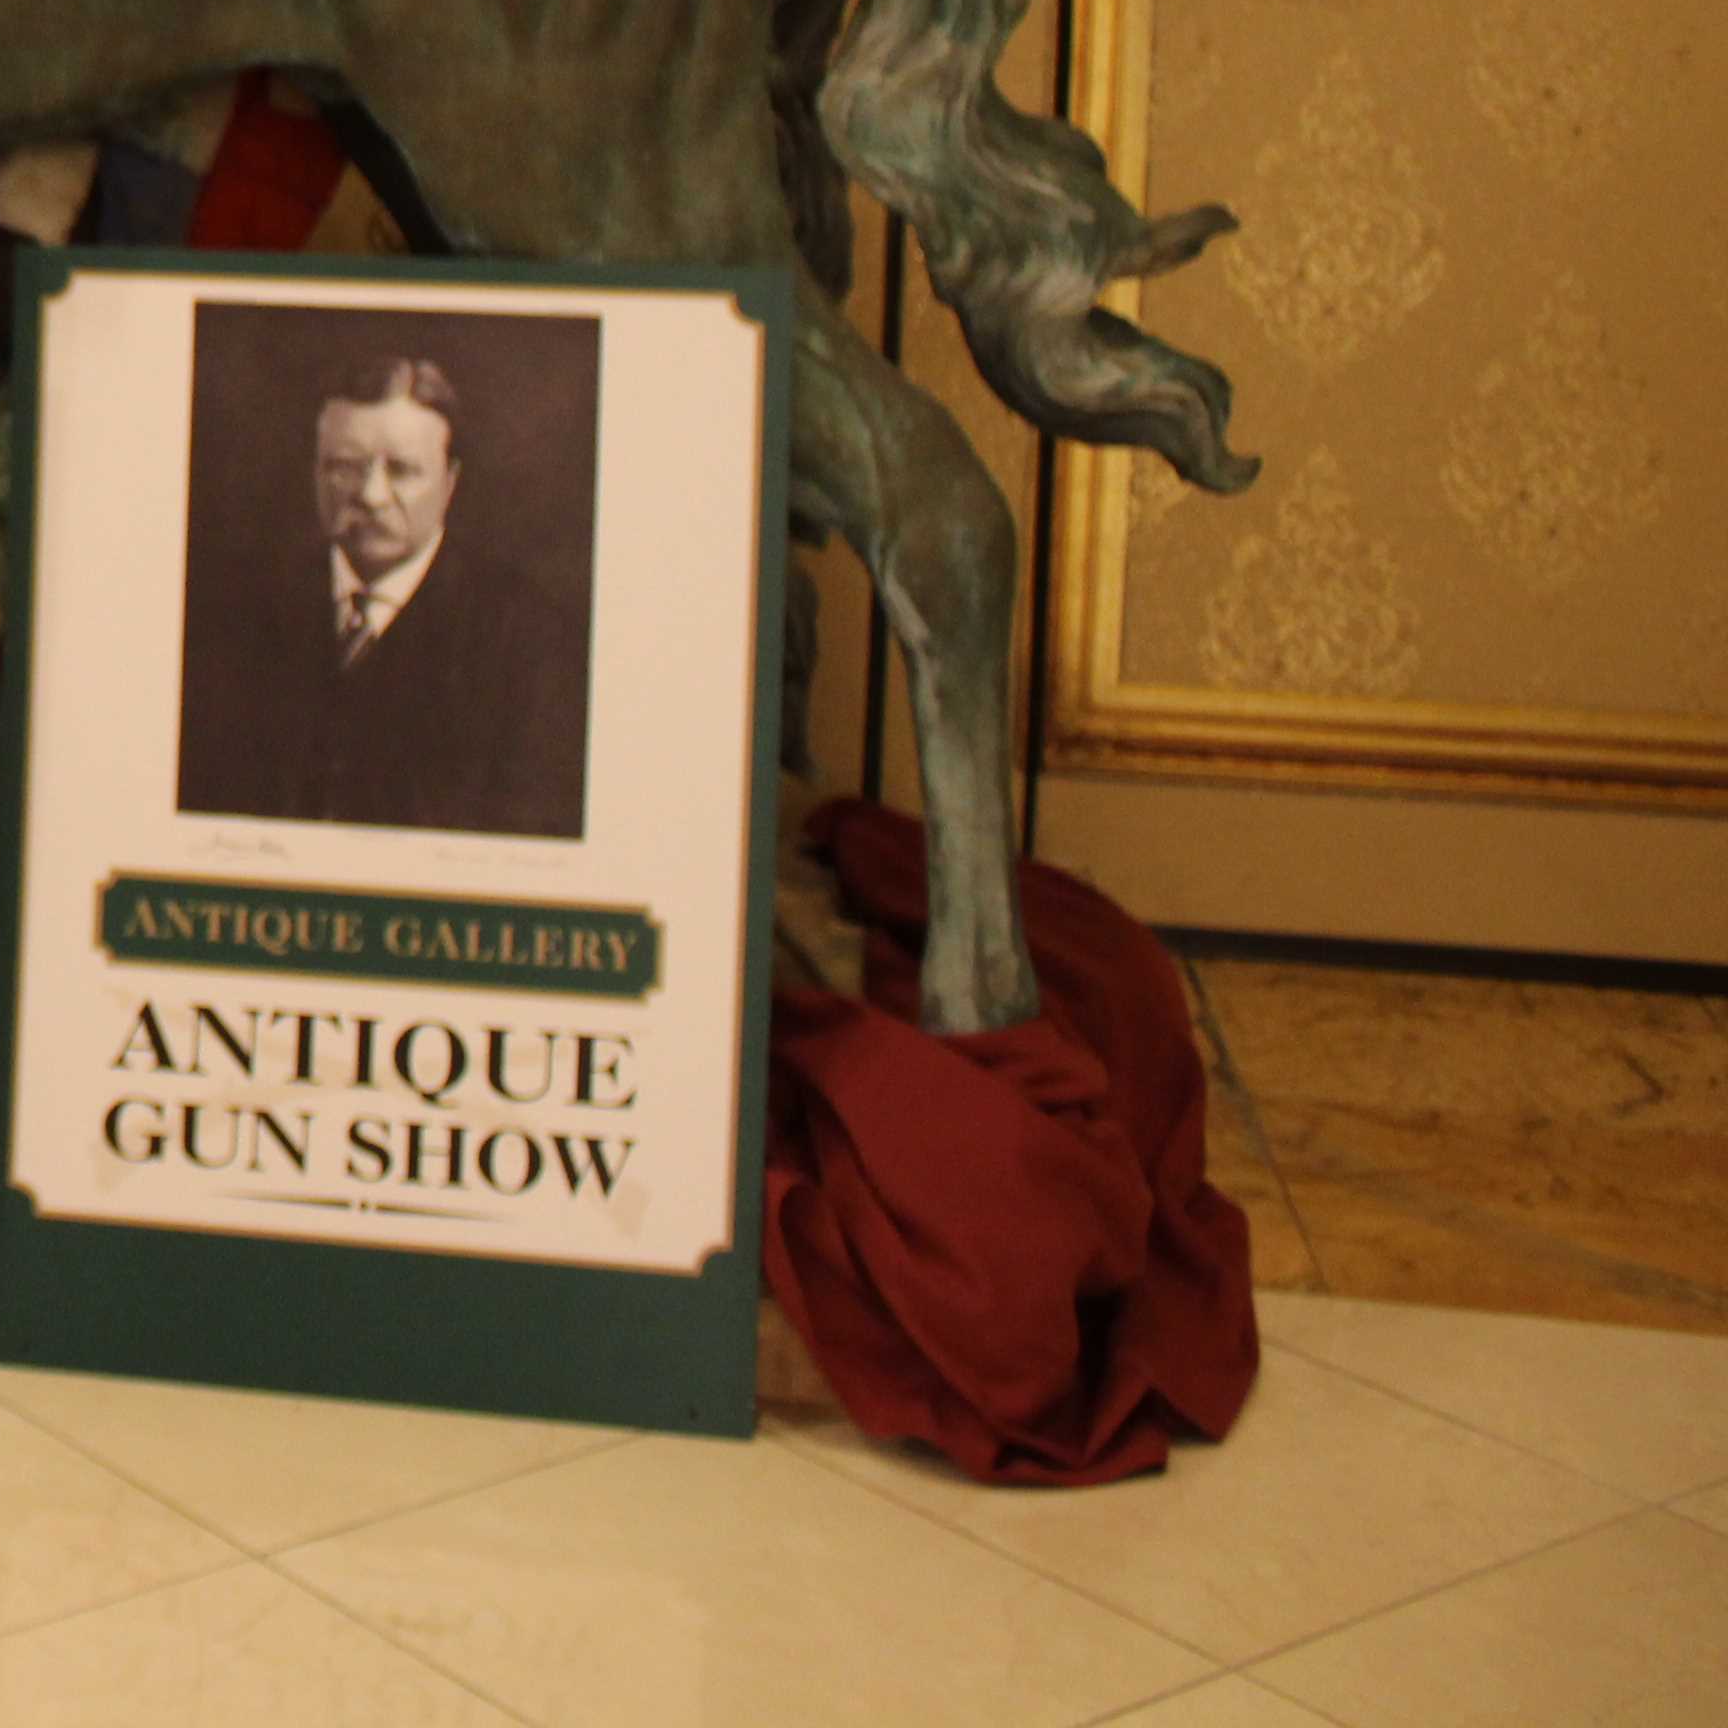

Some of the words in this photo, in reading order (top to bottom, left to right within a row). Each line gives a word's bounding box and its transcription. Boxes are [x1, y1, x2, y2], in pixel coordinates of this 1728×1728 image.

[124, 896, 365, 955] ANTIQUE
[384, 919, 640, 973] GALLERY
[111, 1000, 639, 1113] ANTIQUE
[103, 1097, 317, 1177] GUN
[345, 1117, 637, 1200] SHOW
